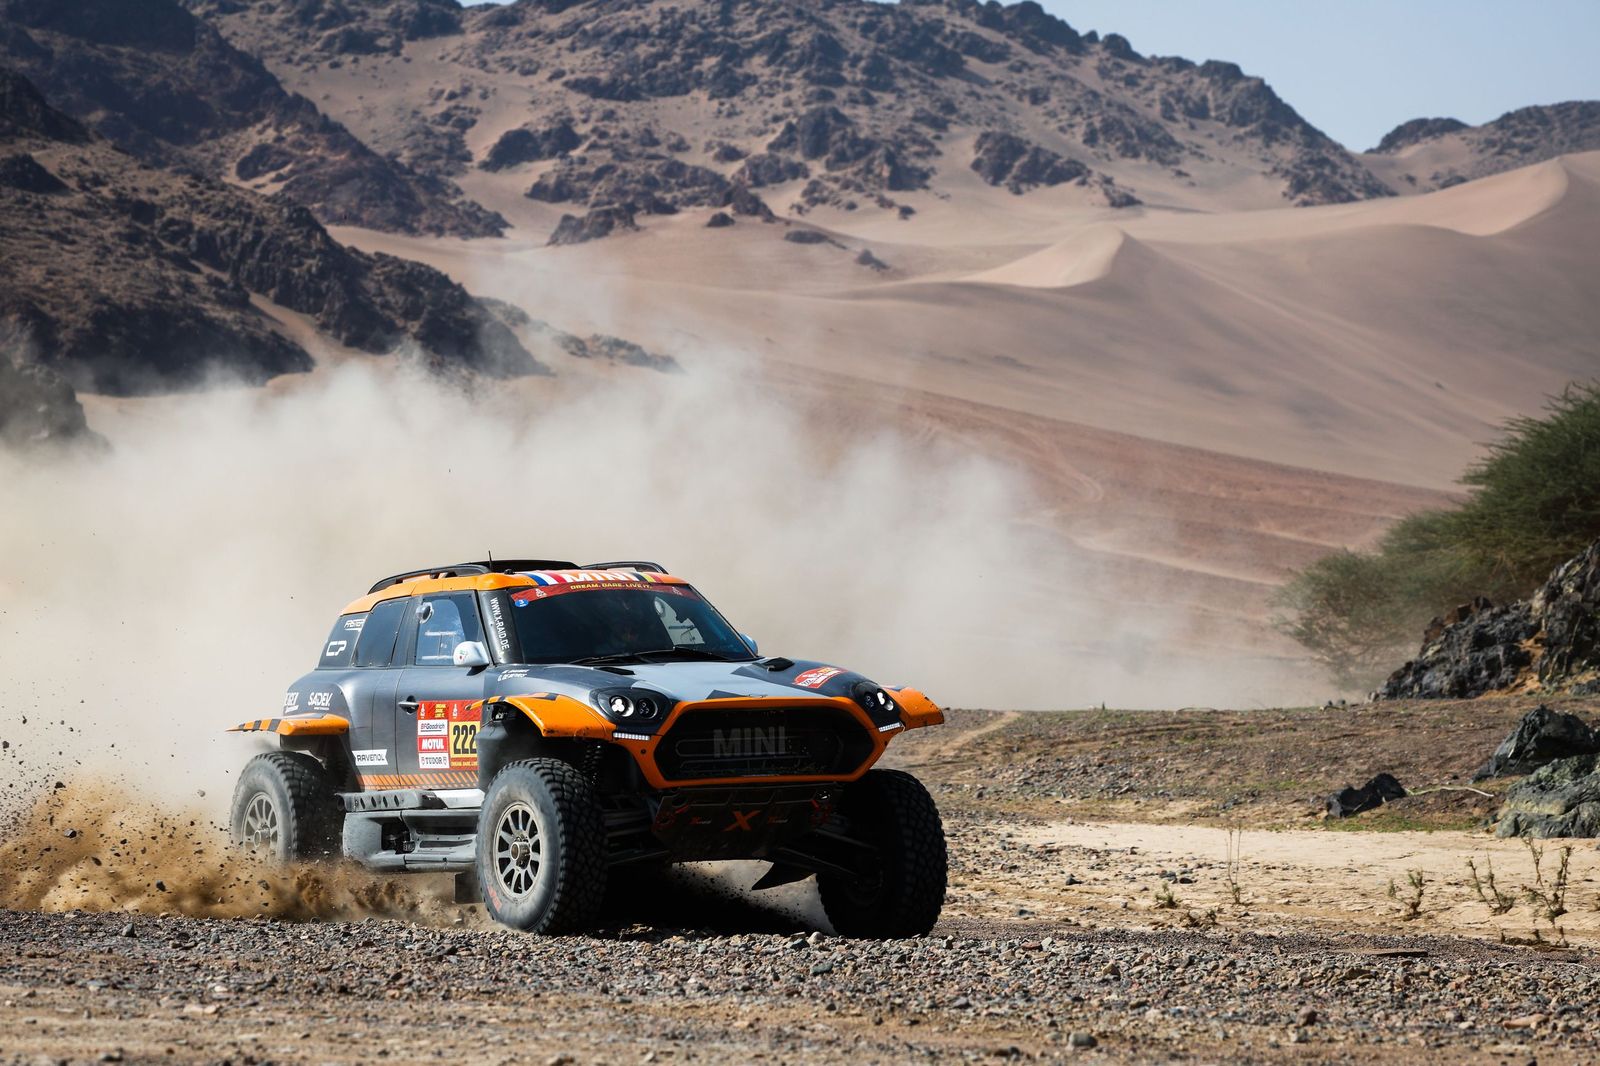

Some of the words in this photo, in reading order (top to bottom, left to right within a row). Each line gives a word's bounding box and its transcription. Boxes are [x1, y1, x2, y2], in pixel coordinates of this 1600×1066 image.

[563, 572, 640, 583] MINI
[490, 597, 510, 650] WWW.X-RAID.DE
[421, 738, 445, 750] MOTUL
[453, 724, 477, 754] 222
[713, 726, 787, 758] MINI
[356, 753, 385, 762] RAVENOL
[425, 756, 442, 765] TUDOR
